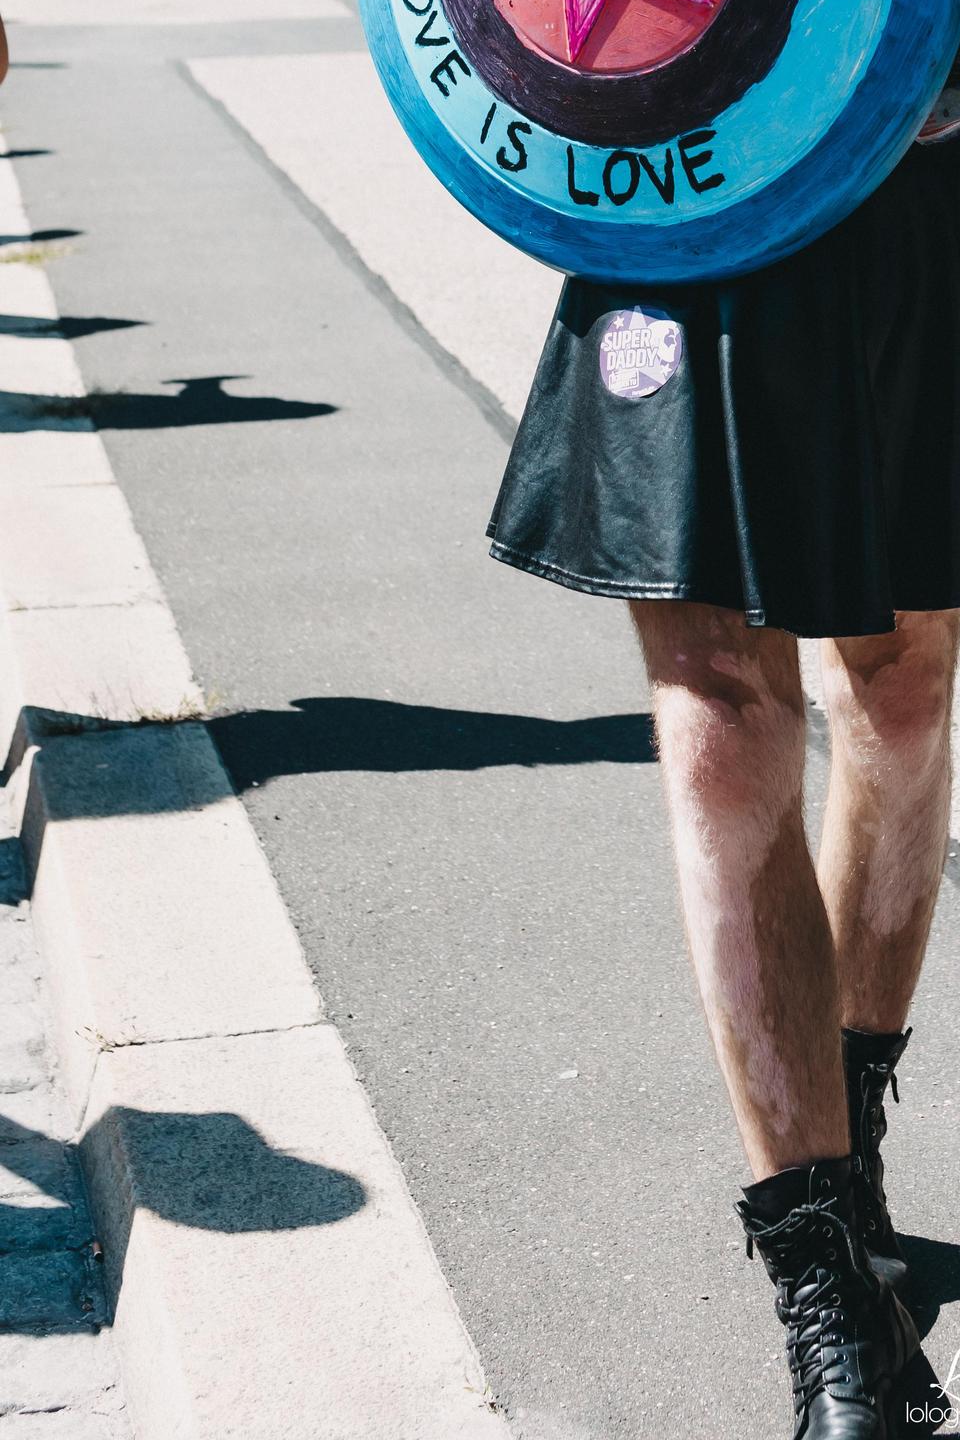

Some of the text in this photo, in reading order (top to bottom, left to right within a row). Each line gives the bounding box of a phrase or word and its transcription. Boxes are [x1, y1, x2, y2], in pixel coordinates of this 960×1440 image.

[480, 105, 533, 173] IS
[566, 129, 726, 206] LOVE
[601, 329, 653, 351] SUPER
[606, 348, 658, 370] DADDY
